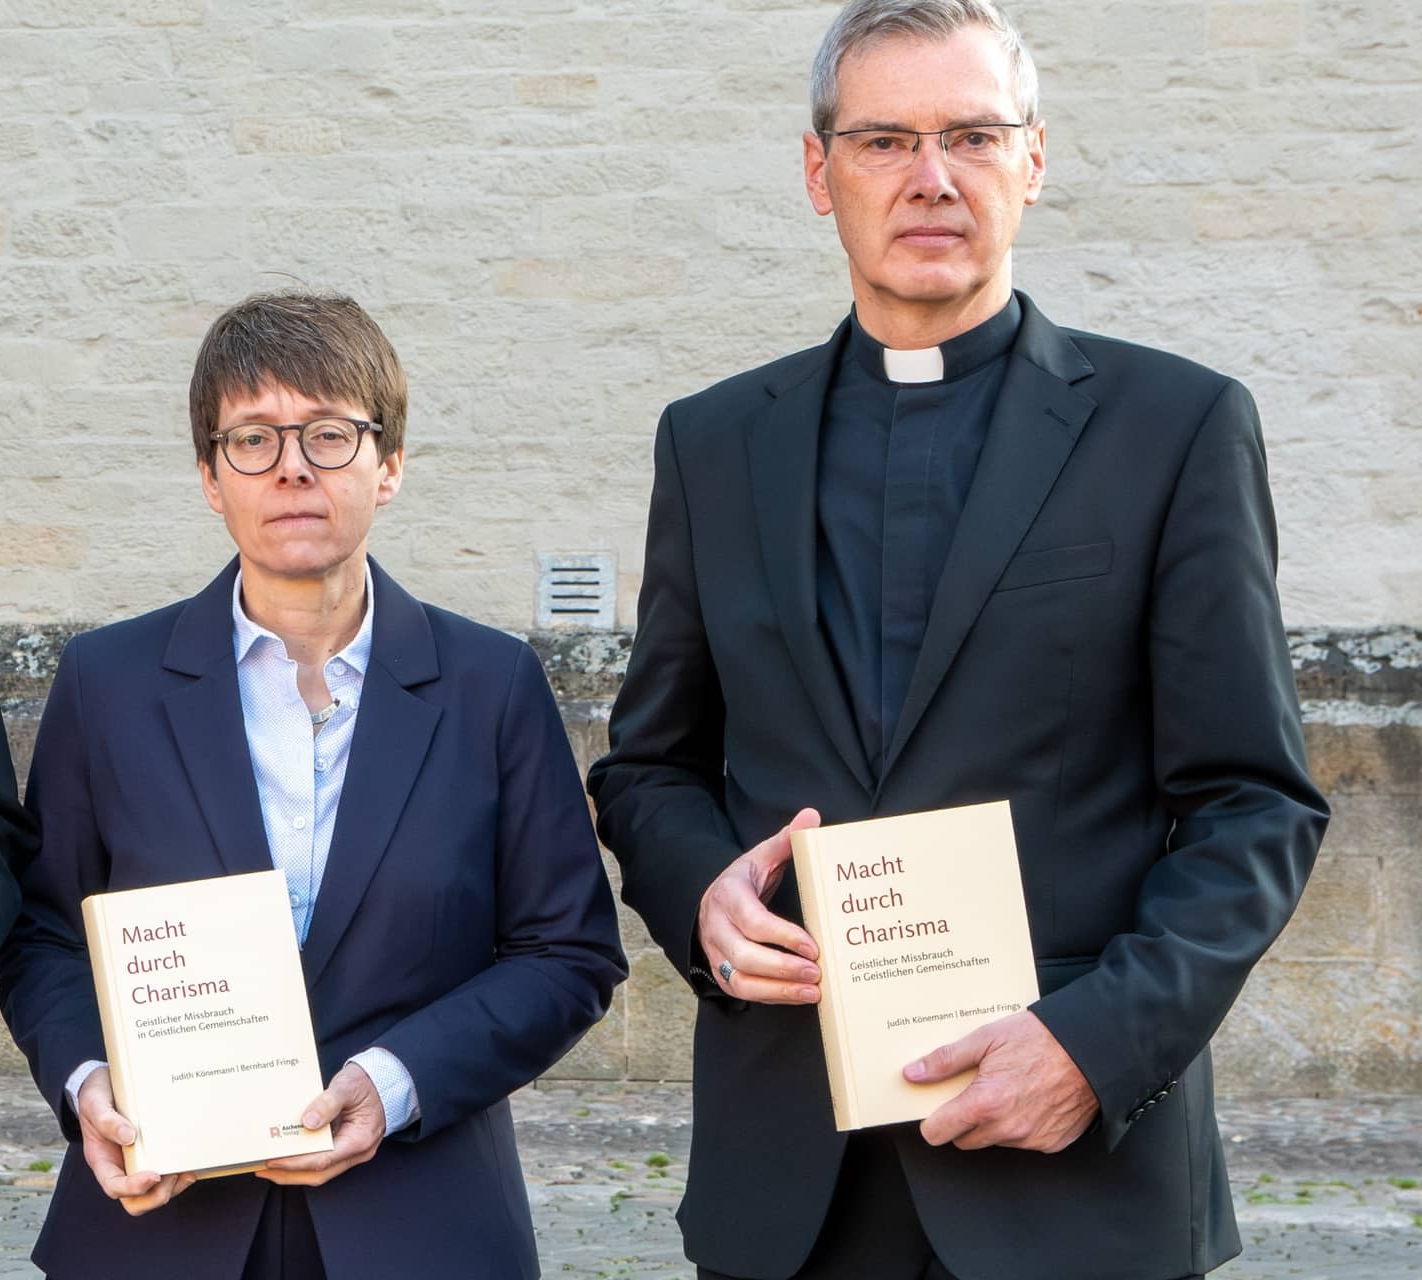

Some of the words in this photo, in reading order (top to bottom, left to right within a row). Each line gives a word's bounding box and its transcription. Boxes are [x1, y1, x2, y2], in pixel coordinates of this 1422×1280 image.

[837, 856, 905, 881] Macht
[841, 888, 903, 913] durch
[122, 920, 187, 944] Macht
[846, 917, 950, 945] Charisma
[127, 950, 186, 974] durch
[850, 957, 898, 970] Geistlicher
[901, 949, 953, 963] Missbrauch
[852, 974, 860, 983] in
[863, 967, 914, 981] Geistlichen
[916, 956, 990, 974] Gemeinschaften
[132, 978, 230, 1004] Charisma
[136, 1014, 182, 1028] Geistlicher
[184, 1007, 234, 1020] Missbrauch
[138, 1031, 146, 1039] in
[148, 1024, 196, 1037] Geistlichen
[199, 1014, 269, 1031] Gemeinschaften
[887, 1018, 910, 1029] Judith
[912, 1011, 954, 1024] Könemann
[960, 1005, 995, 1017] Bernhard
[996, 1002, 1021, 1013] Frings
[172, 1072, 194, 1082] Judith
[196, 1065, 235, 1077] Könemann
[241, 1060, 274, 1071] Bernhard
[276, 1057, 299, 1068] Frings
